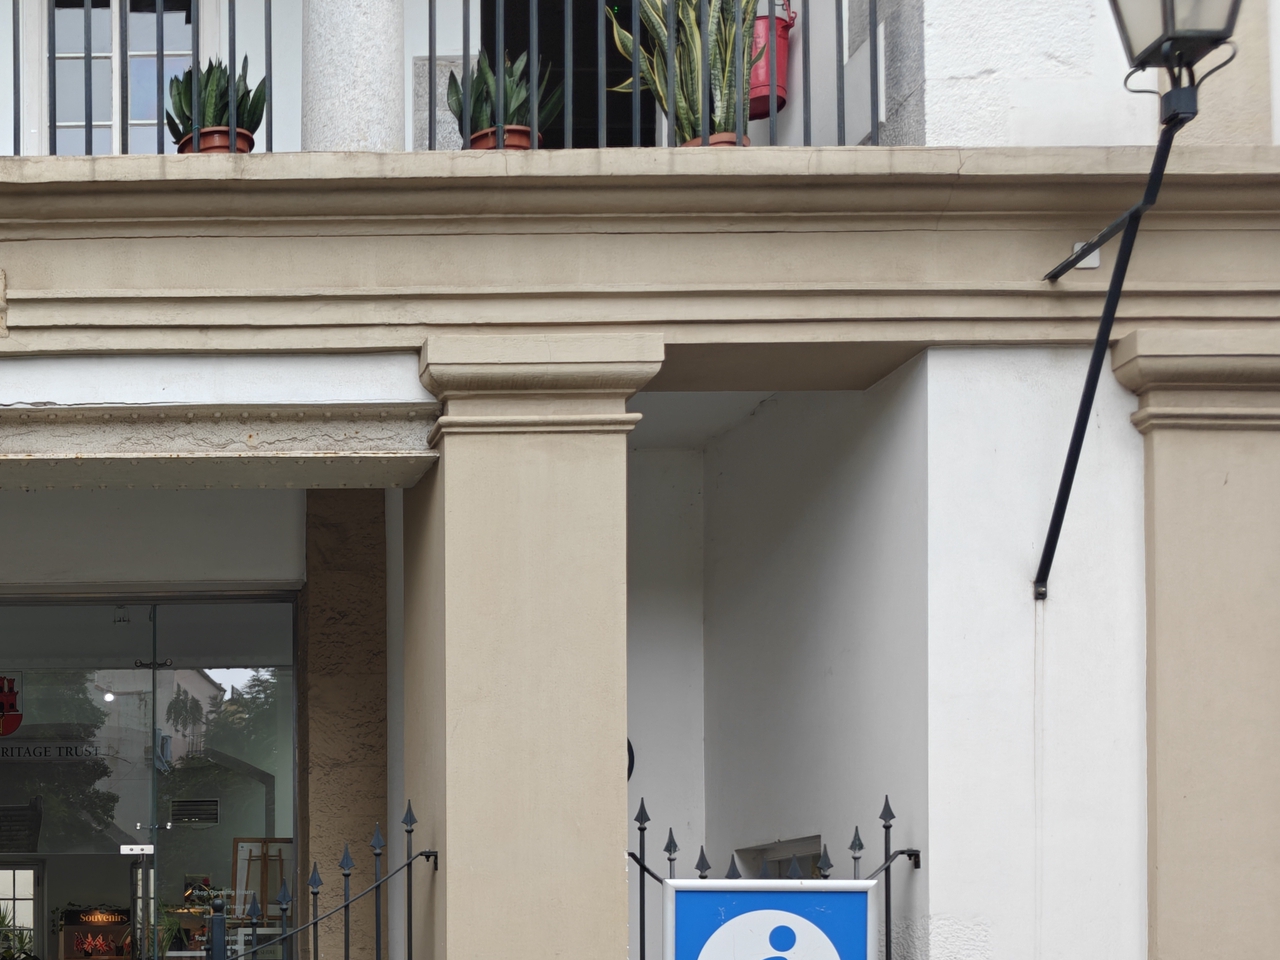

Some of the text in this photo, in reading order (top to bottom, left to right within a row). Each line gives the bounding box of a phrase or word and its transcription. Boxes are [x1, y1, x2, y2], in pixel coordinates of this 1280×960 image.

[57, 746, 100, 757] TRUST
[192, 889, 208, 897] Shop
[209, 889, 235, 897] Opening
[80, 913, 128, 922] Souvenirs
